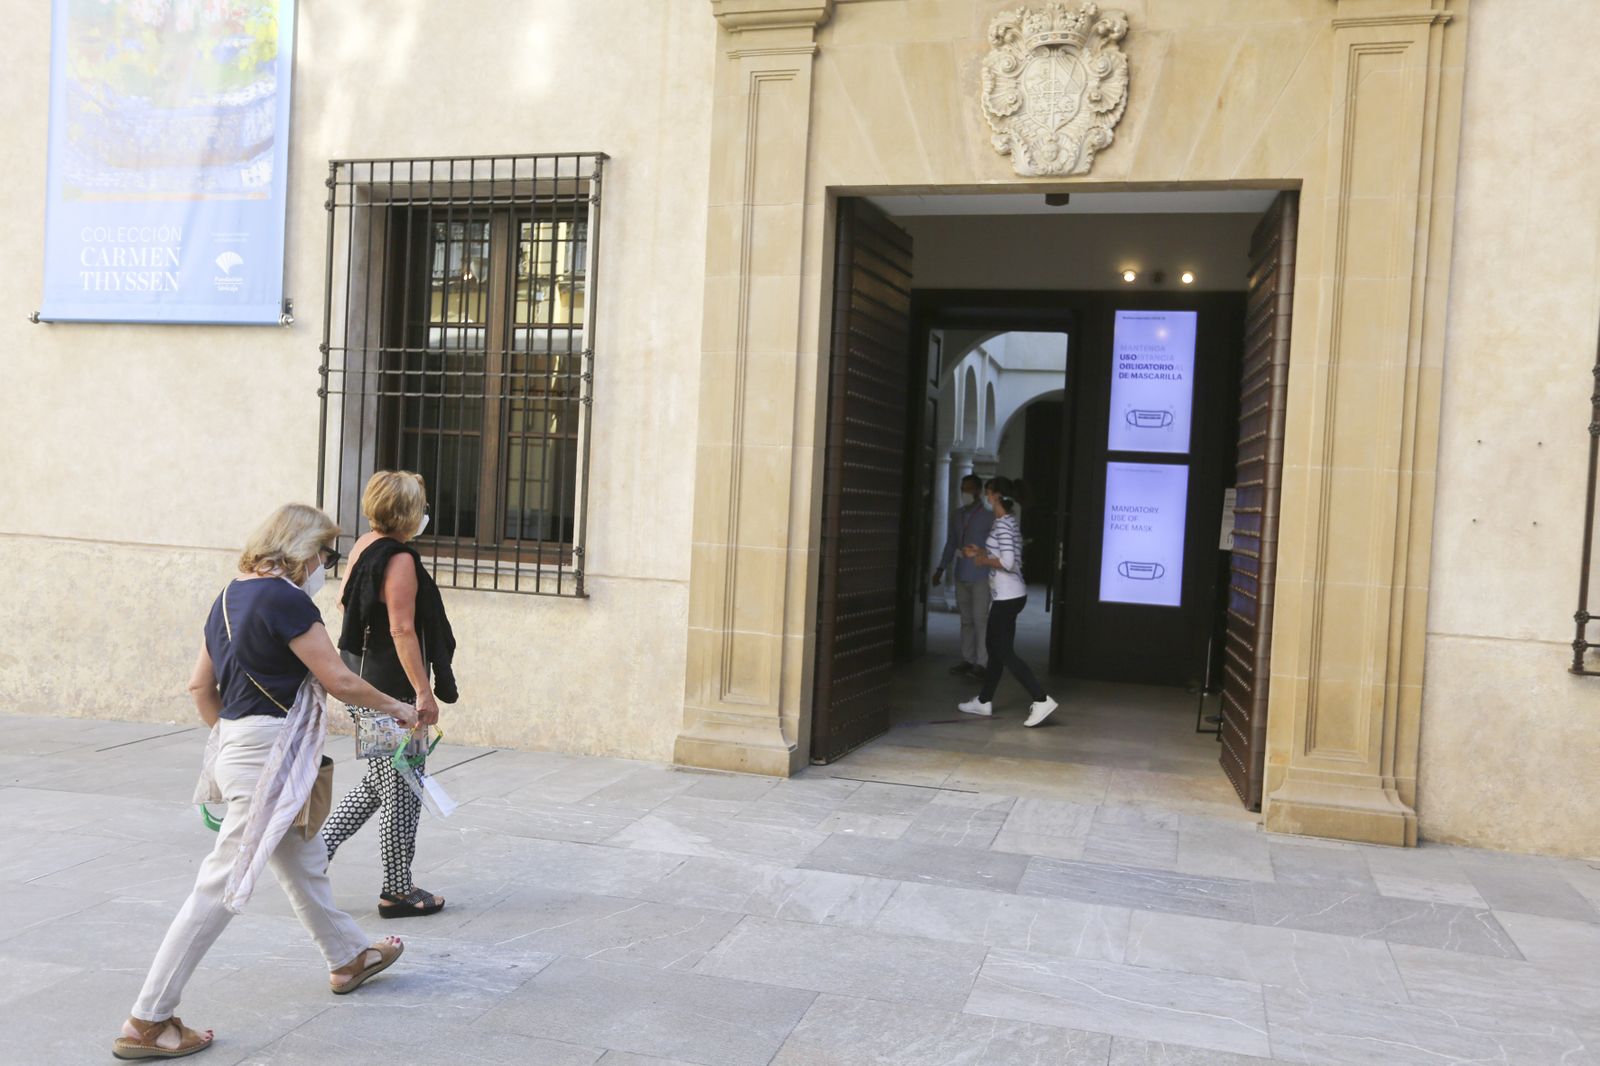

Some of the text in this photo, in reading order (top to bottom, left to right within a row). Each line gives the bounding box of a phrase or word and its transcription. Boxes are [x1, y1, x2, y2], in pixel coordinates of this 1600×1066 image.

[80, 224, 182, 242] COLECCIÓN
[80, 246, 181, 267] CARMEN
[79, 271, 180, 291] THYSSEN
[1119, 353, 1137, 361] USO
[1119, 363, 1174, 371] OBLIGATORIO
[1111, 505, 1159, 513] MANDATORY
